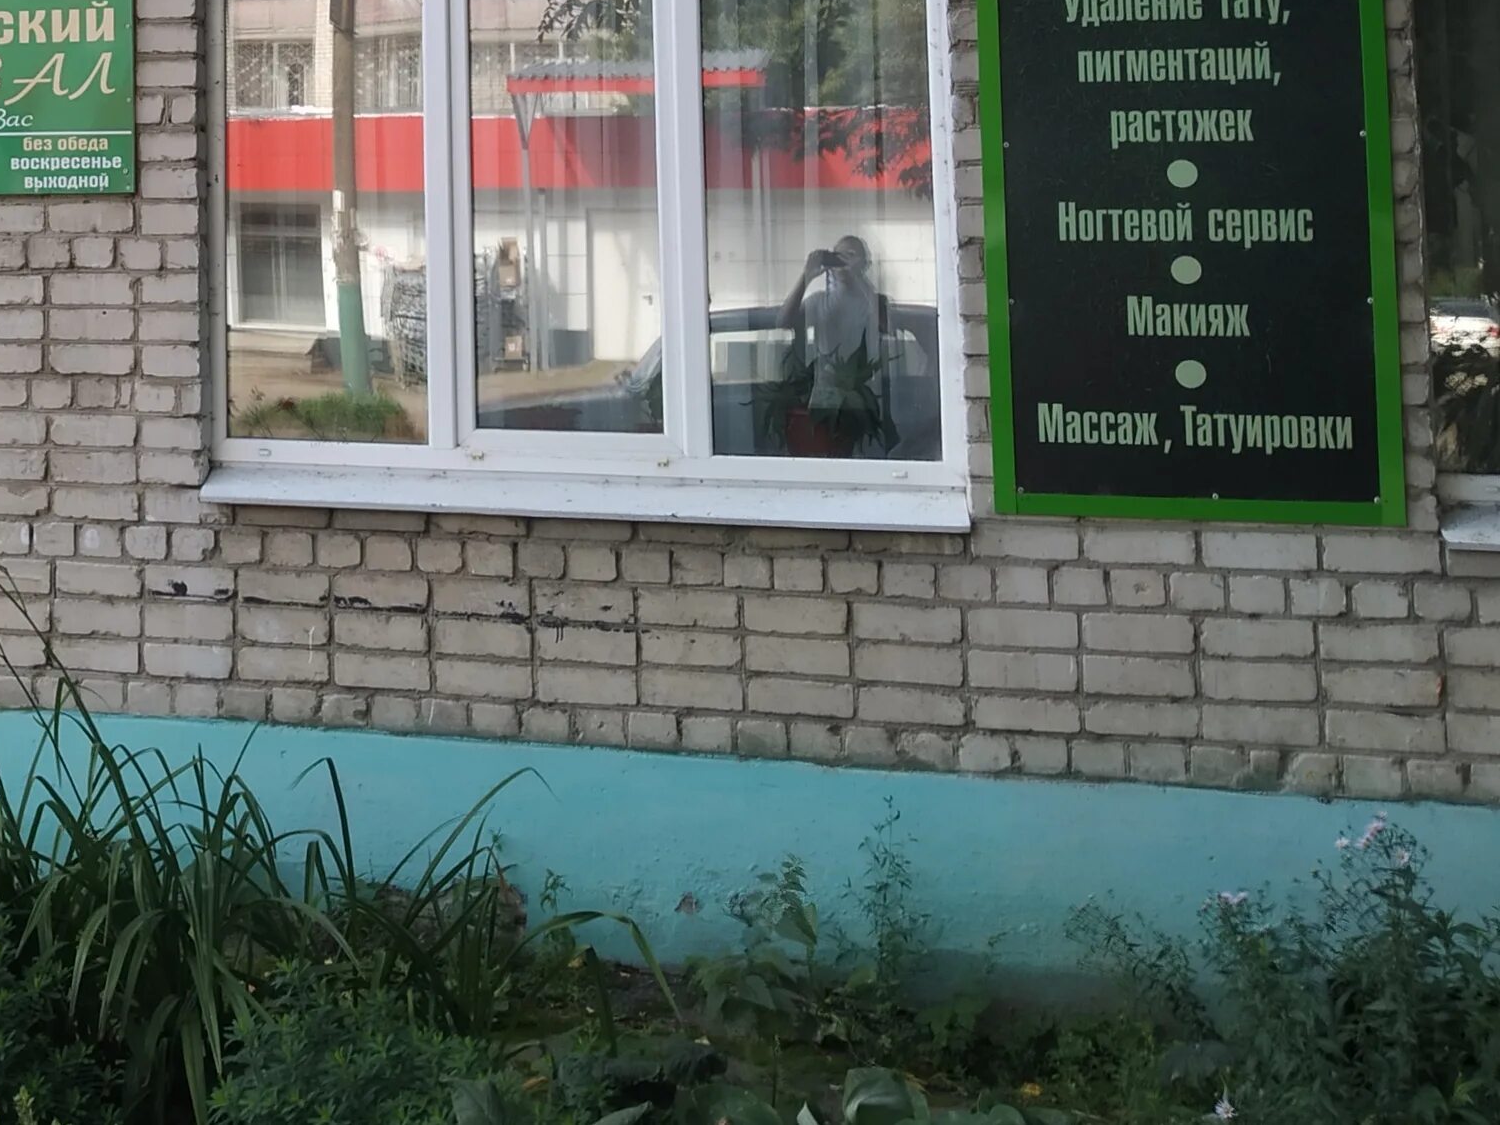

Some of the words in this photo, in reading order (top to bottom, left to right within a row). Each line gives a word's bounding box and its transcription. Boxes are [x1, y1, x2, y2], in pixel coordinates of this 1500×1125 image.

[1077, 41, 1281, 86] пигментаций,
[23, 136, 53, 151] без
[57, 136, 109, 152] обеда
[1110, 108, 1254, 150] растяжек
[10, 156, 122, 171] воскресенье
[24, 173, 109, 190] выходной
[1058, 201, 1193, 242] Ногтевой
[1207, 207, 1315, 250] сервис
[1126, 296, 1251, 338] Макияж
[1179, 404, 1354, 455] Татуировки
